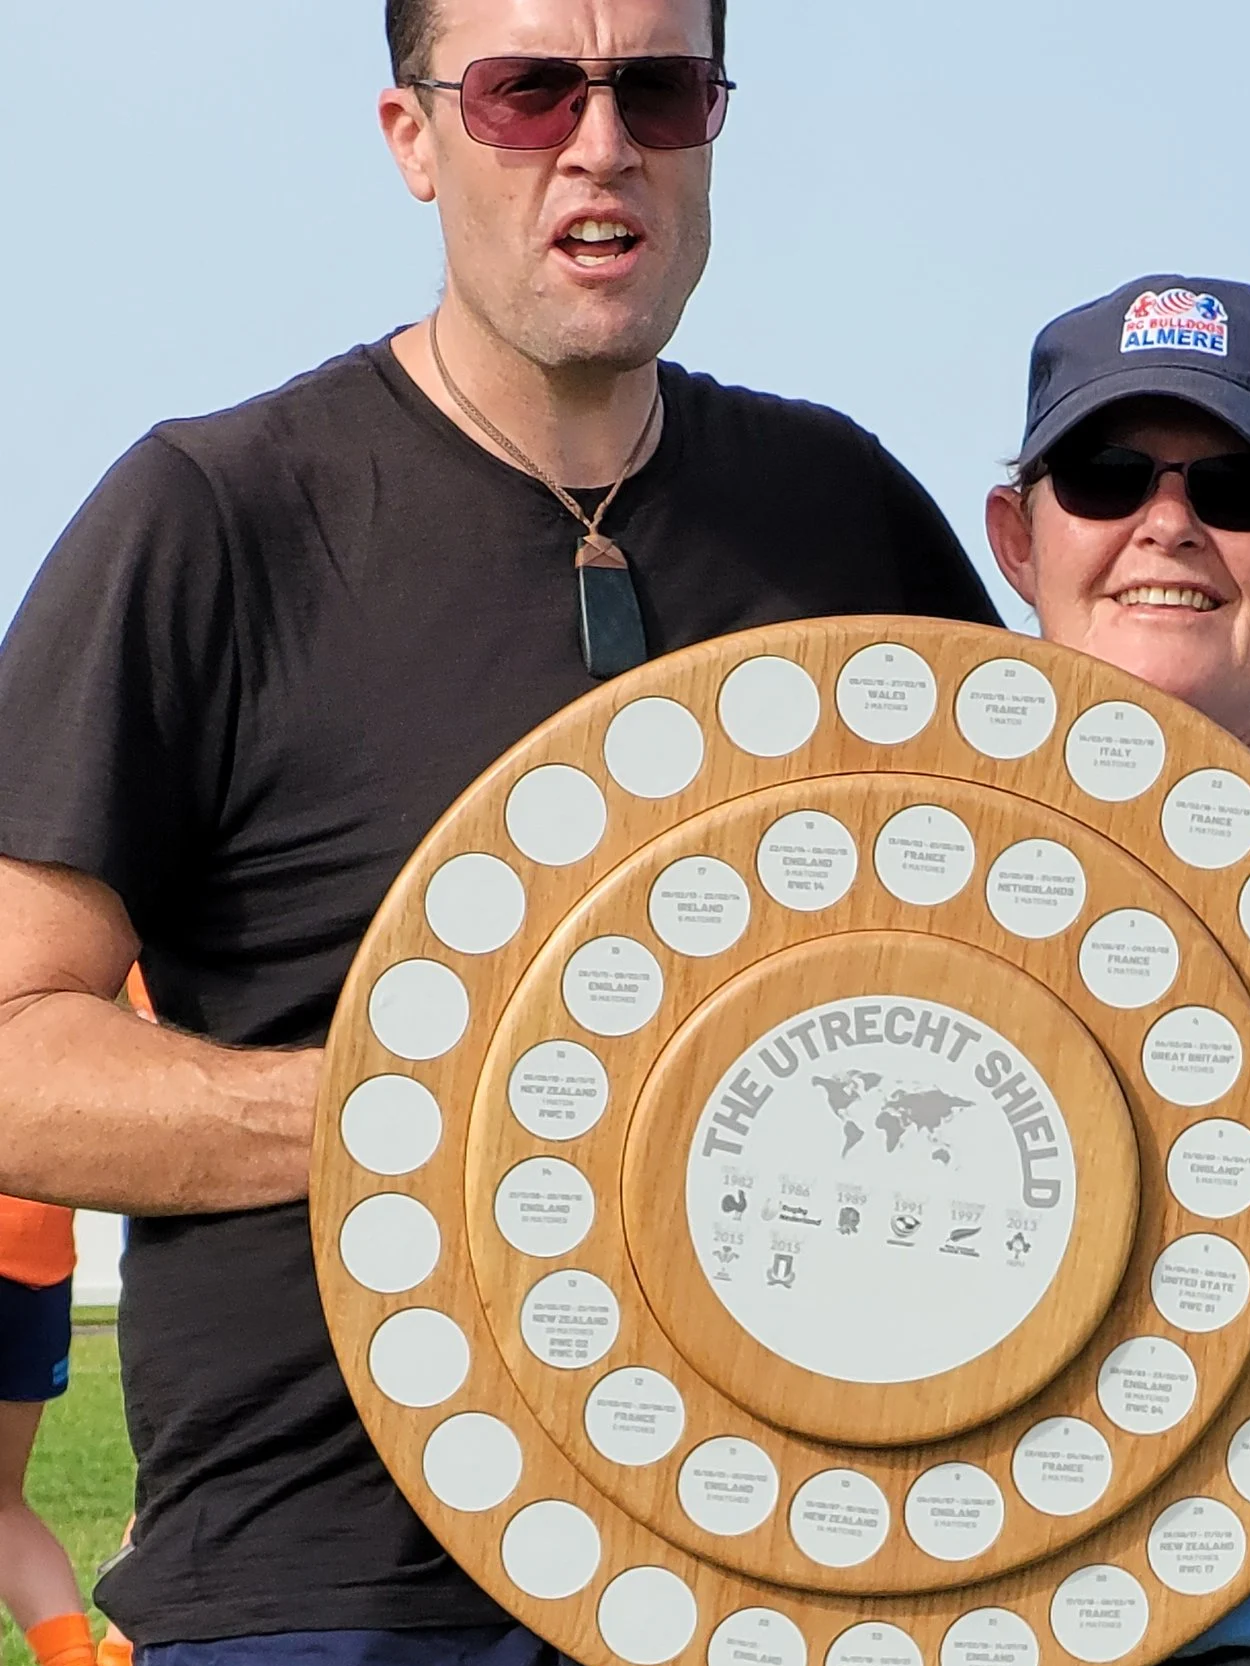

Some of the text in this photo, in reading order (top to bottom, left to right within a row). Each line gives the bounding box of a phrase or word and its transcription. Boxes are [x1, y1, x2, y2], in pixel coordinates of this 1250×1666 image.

[1150, 318, 1224, 335] BULLDOGS
[1125, 329, 1224, 351] ALMERE
[867, 689, 906, 701] WALES
[985, 703, 1029, 716] FRANCE
[1099, 746, 1132, 758] ITALY
[1190, 812, 1233, 827] FRANCE
[782, 856, 833, 868] ENGLAND
[903, 849, 947, 863] FRANCE
[997, 882, 1074, 897] NETHERLANDS
[677, 902, 724, 913] IRELAND
[1107, 953, 1151, 966] FRANCE
[520, 1084, 598, 1098] NEW ZEALAND
[701, 1004, 1062, 1209] THE UTRECHT SHIELD
[532, 1313, 609, 1327] NEW ZEALAND
[1122, 1378, 1173, 1393] ENGLAND
[613, 1411, 656, 1424] FRANCE
[1042, 1461, 1084, 1473] FRANCE
[802, 1510, 879, 1529] NEW ZEALAND
[1159, 1542, 1235, 1551] NEW ZEALAND
[1079, 1608, 1121, 1619] FRANCE
